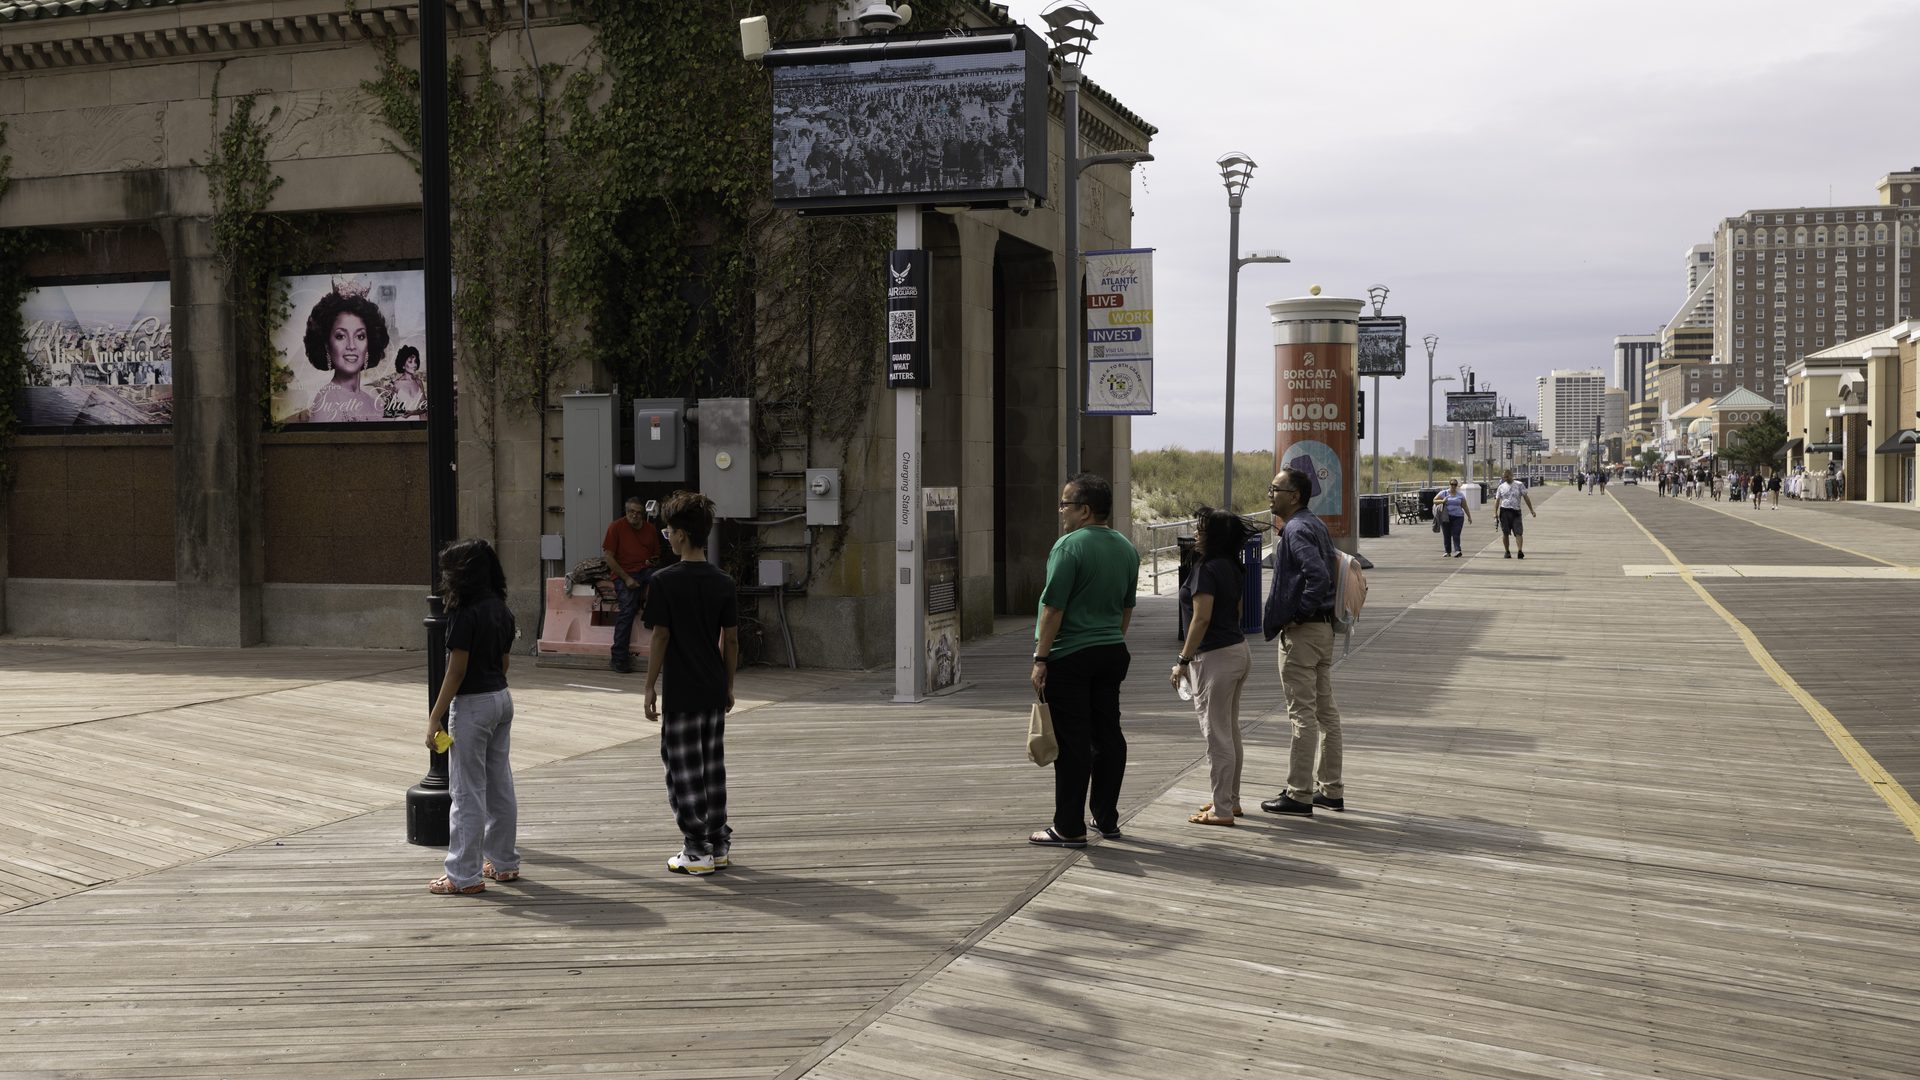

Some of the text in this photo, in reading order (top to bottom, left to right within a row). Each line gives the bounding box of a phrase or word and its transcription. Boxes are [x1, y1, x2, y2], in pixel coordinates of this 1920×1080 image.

[1101, 277, 1138, 285] ATLANTIC
[888, 287, 899, 297] AIR
[1111, 284, 1128, 292] CITY
[1092, 295, 1117, 307] LIVE
[1112, 311, 1151, 323] WORK
[1093, 329, 1135, 341] INVEST
[44, 340, 155, 374] Miss America
[892, 353, 911, 361] GUARD
[893, 362, 909, 370] WHAT
[889, 372, 916, 381] MATTERS.
[1129, 366, 1142, 382] GRADE
[1283, 369, 1337, 379] BORGATA
[1287, 380, 1332, 389] ONLINE
[1283, 403, 1338, 421] 1,000
[1277, 422, 1346, 431] BONUS SPINS
[901, 451, 911, 525] Charging Station
